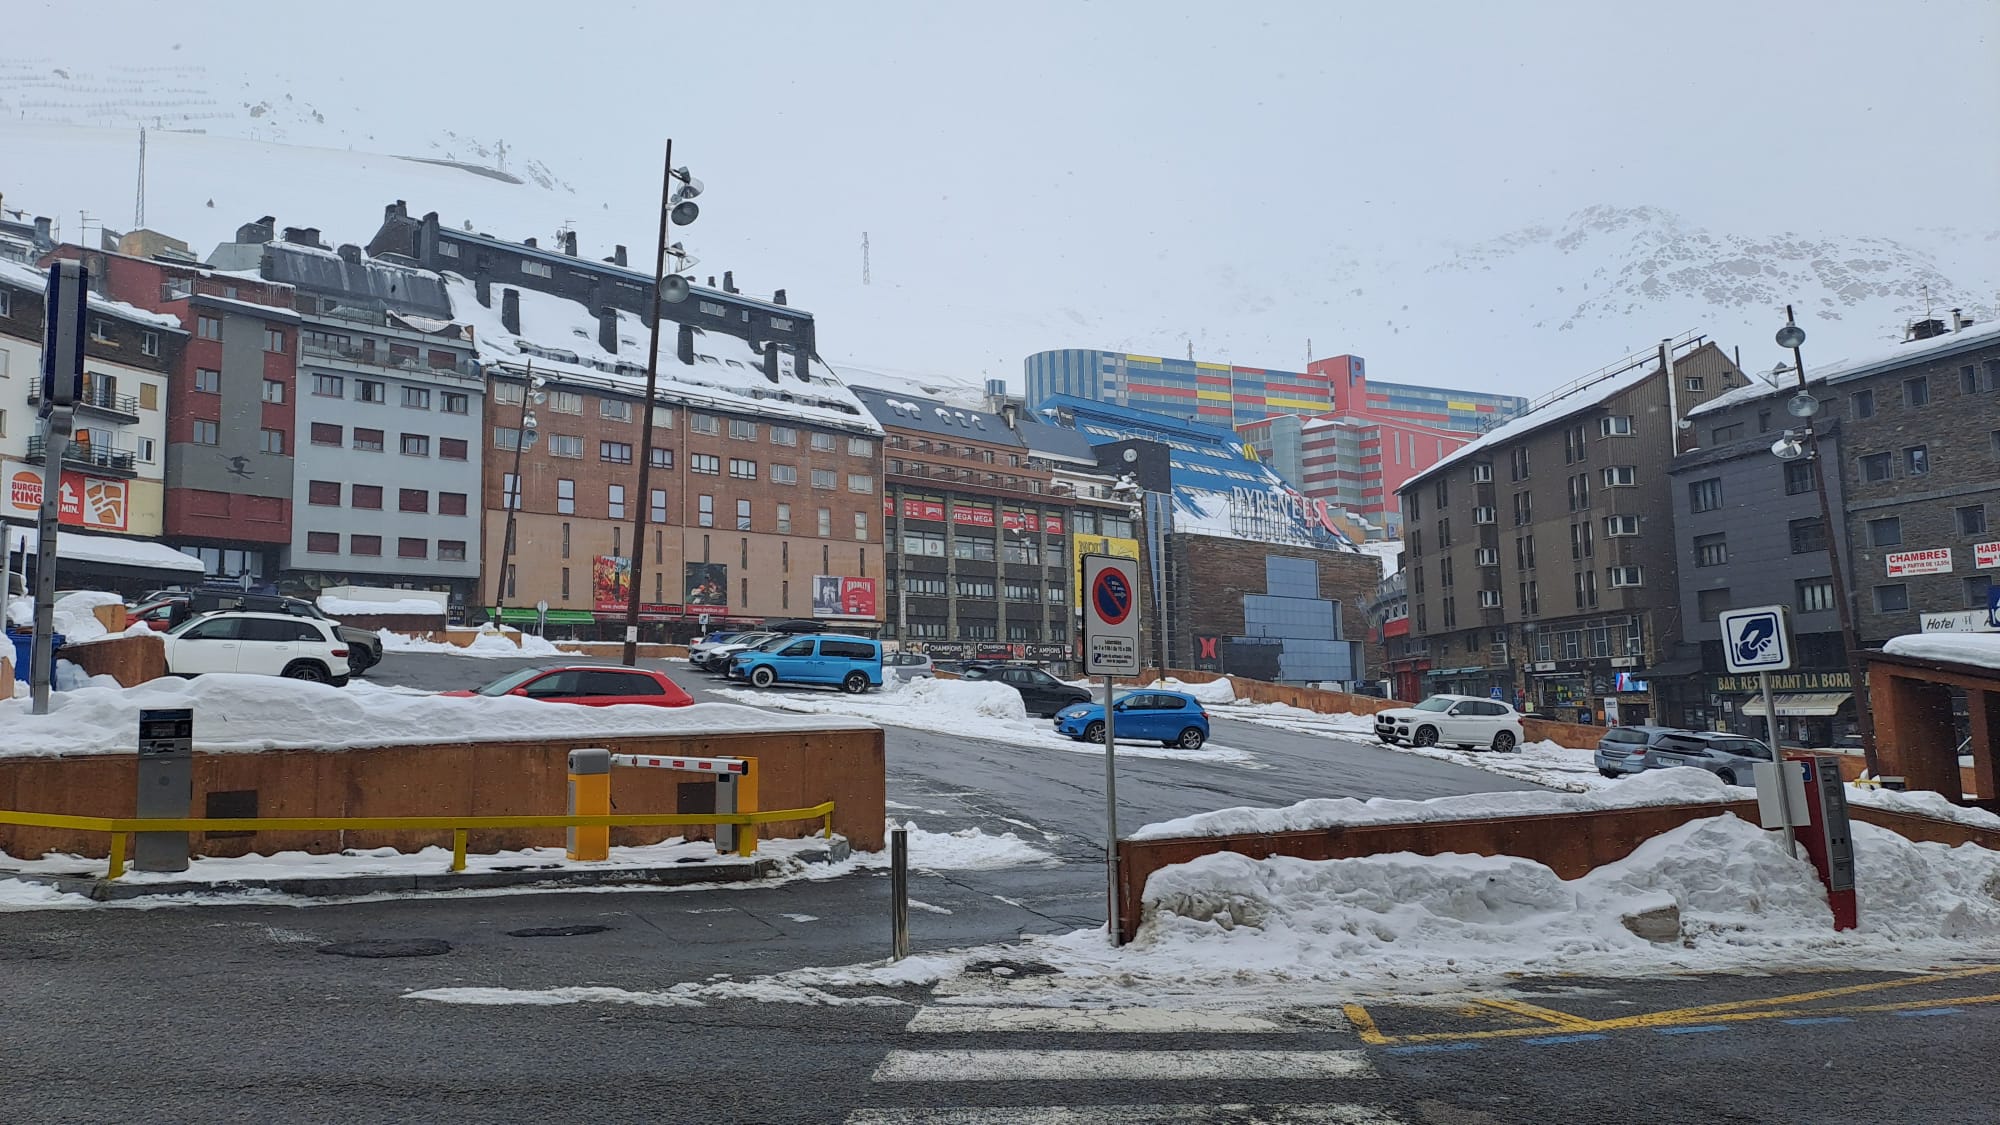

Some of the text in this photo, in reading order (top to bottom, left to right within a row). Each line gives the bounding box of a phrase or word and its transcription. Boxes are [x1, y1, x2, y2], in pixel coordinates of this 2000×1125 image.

[12, 482, 42, 493] BURGER
[12, 491, 42, 505] KING
[61, 503, 79, 515] MIN.
[973, 514, 993, 523] MEGA
[1889, 550, 1948, 564] CHAMBRES
[1926, 616, 1956, 631] Hotel
[1032, 647, 1061, 655] CAMPIONS
[1803, 673, 1818, 689] LA
